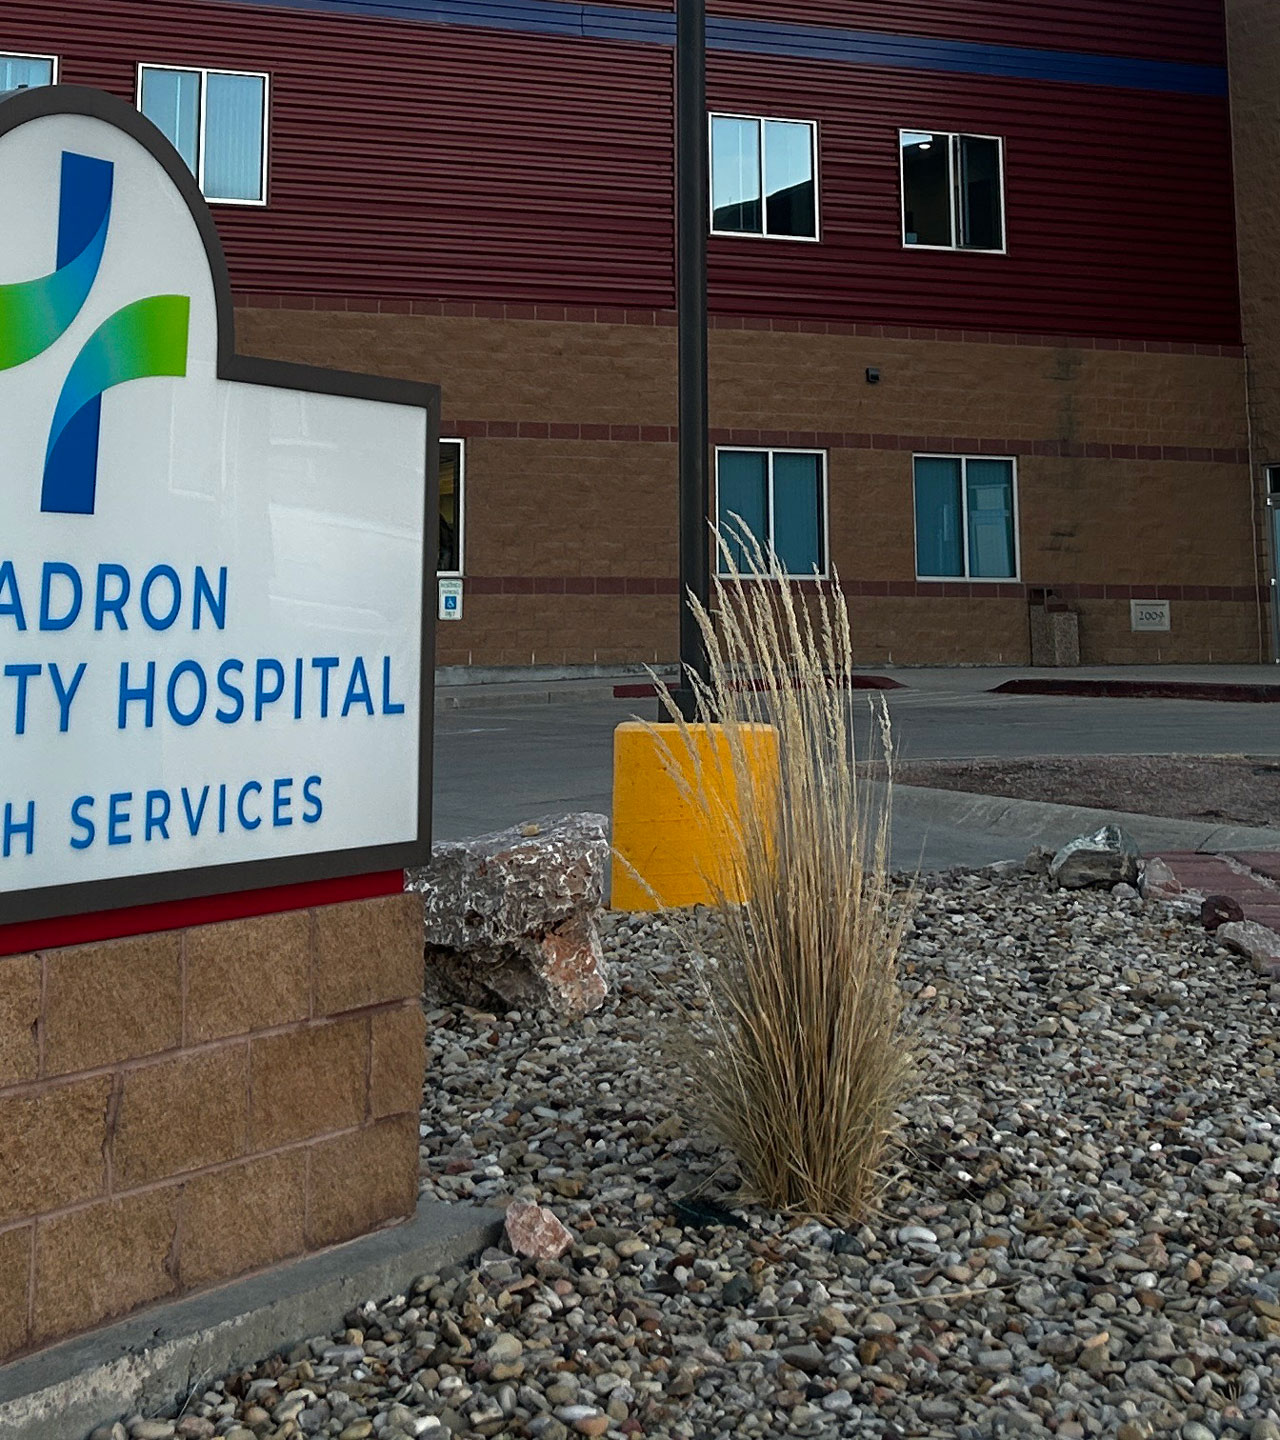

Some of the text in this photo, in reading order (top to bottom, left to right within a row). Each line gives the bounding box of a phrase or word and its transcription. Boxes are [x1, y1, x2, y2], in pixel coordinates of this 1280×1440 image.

[1138, 611, 1166, 624] 2009
[117, 655, 406, 731] HOSPITAL
[69, 774, 324, 851] SERVICES
